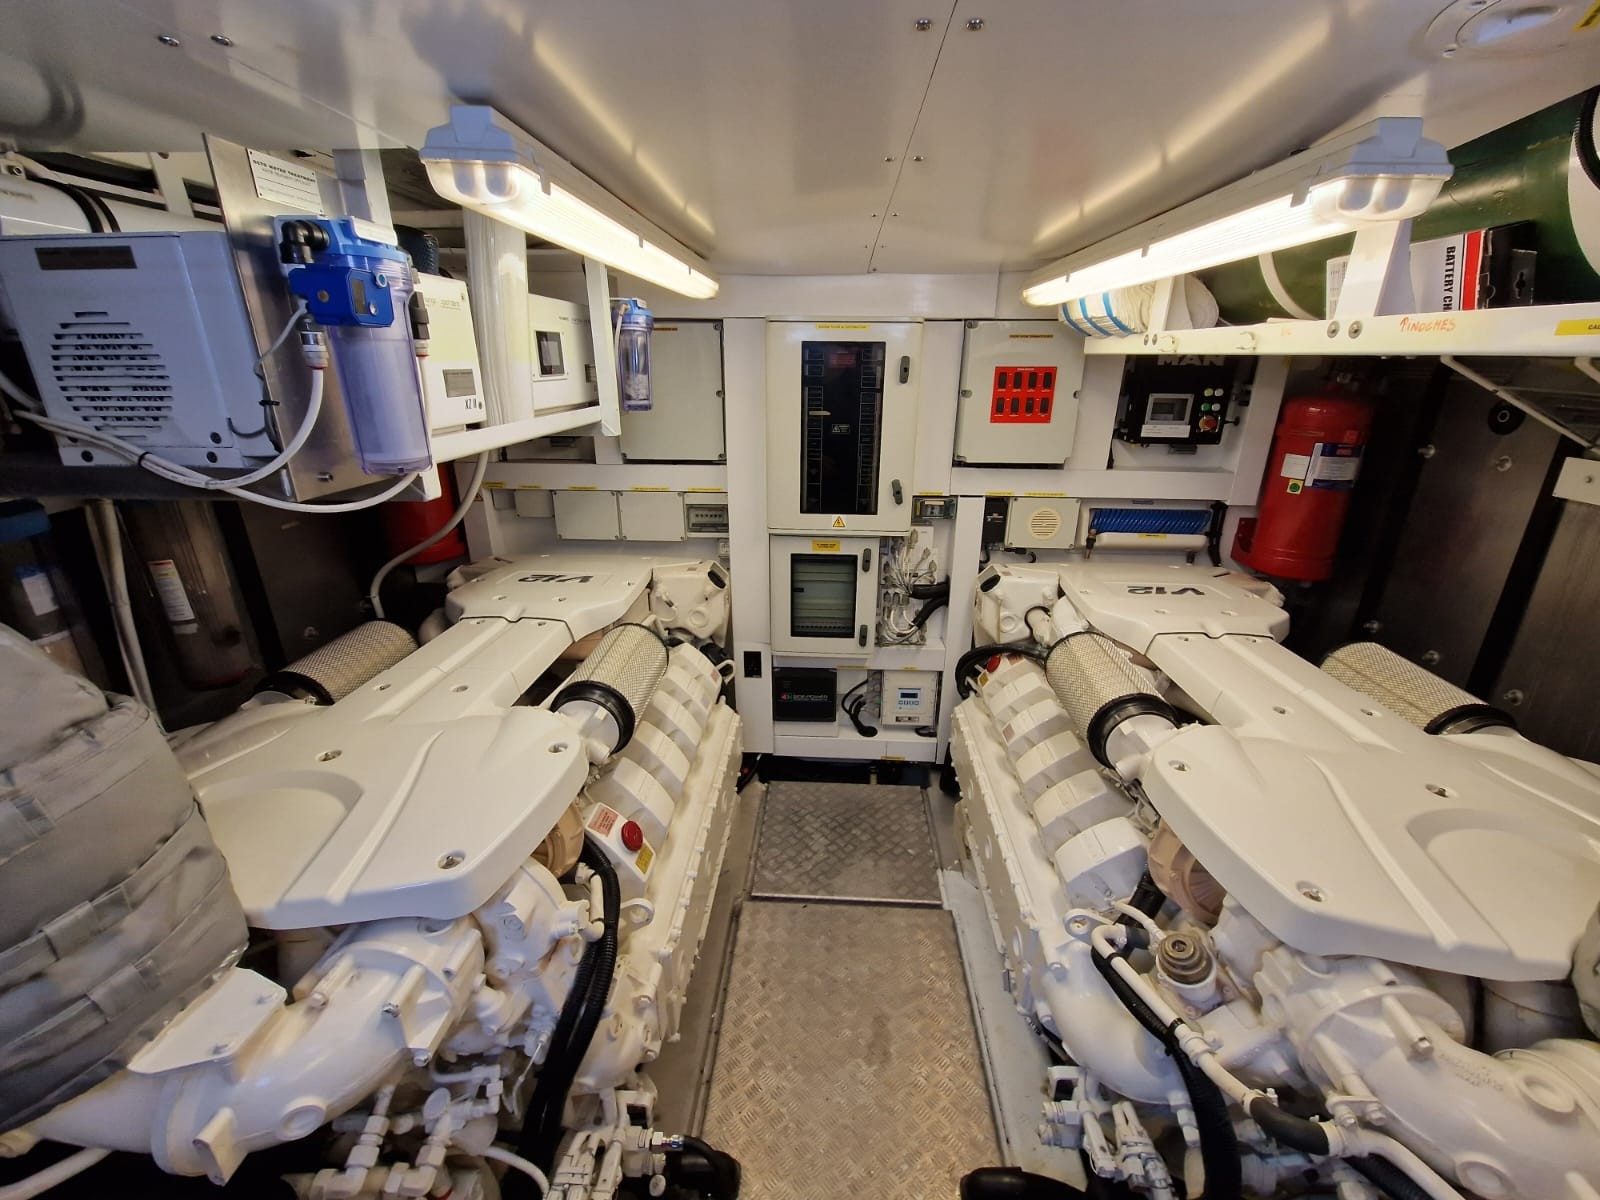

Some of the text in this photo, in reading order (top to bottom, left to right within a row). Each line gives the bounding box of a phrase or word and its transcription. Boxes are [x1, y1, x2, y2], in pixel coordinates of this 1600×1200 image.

[1442, 246, 1456, 312] BATTERY CH
[517, 574, 594, 583] V12
[1127, 585, 1205, 595] V12
